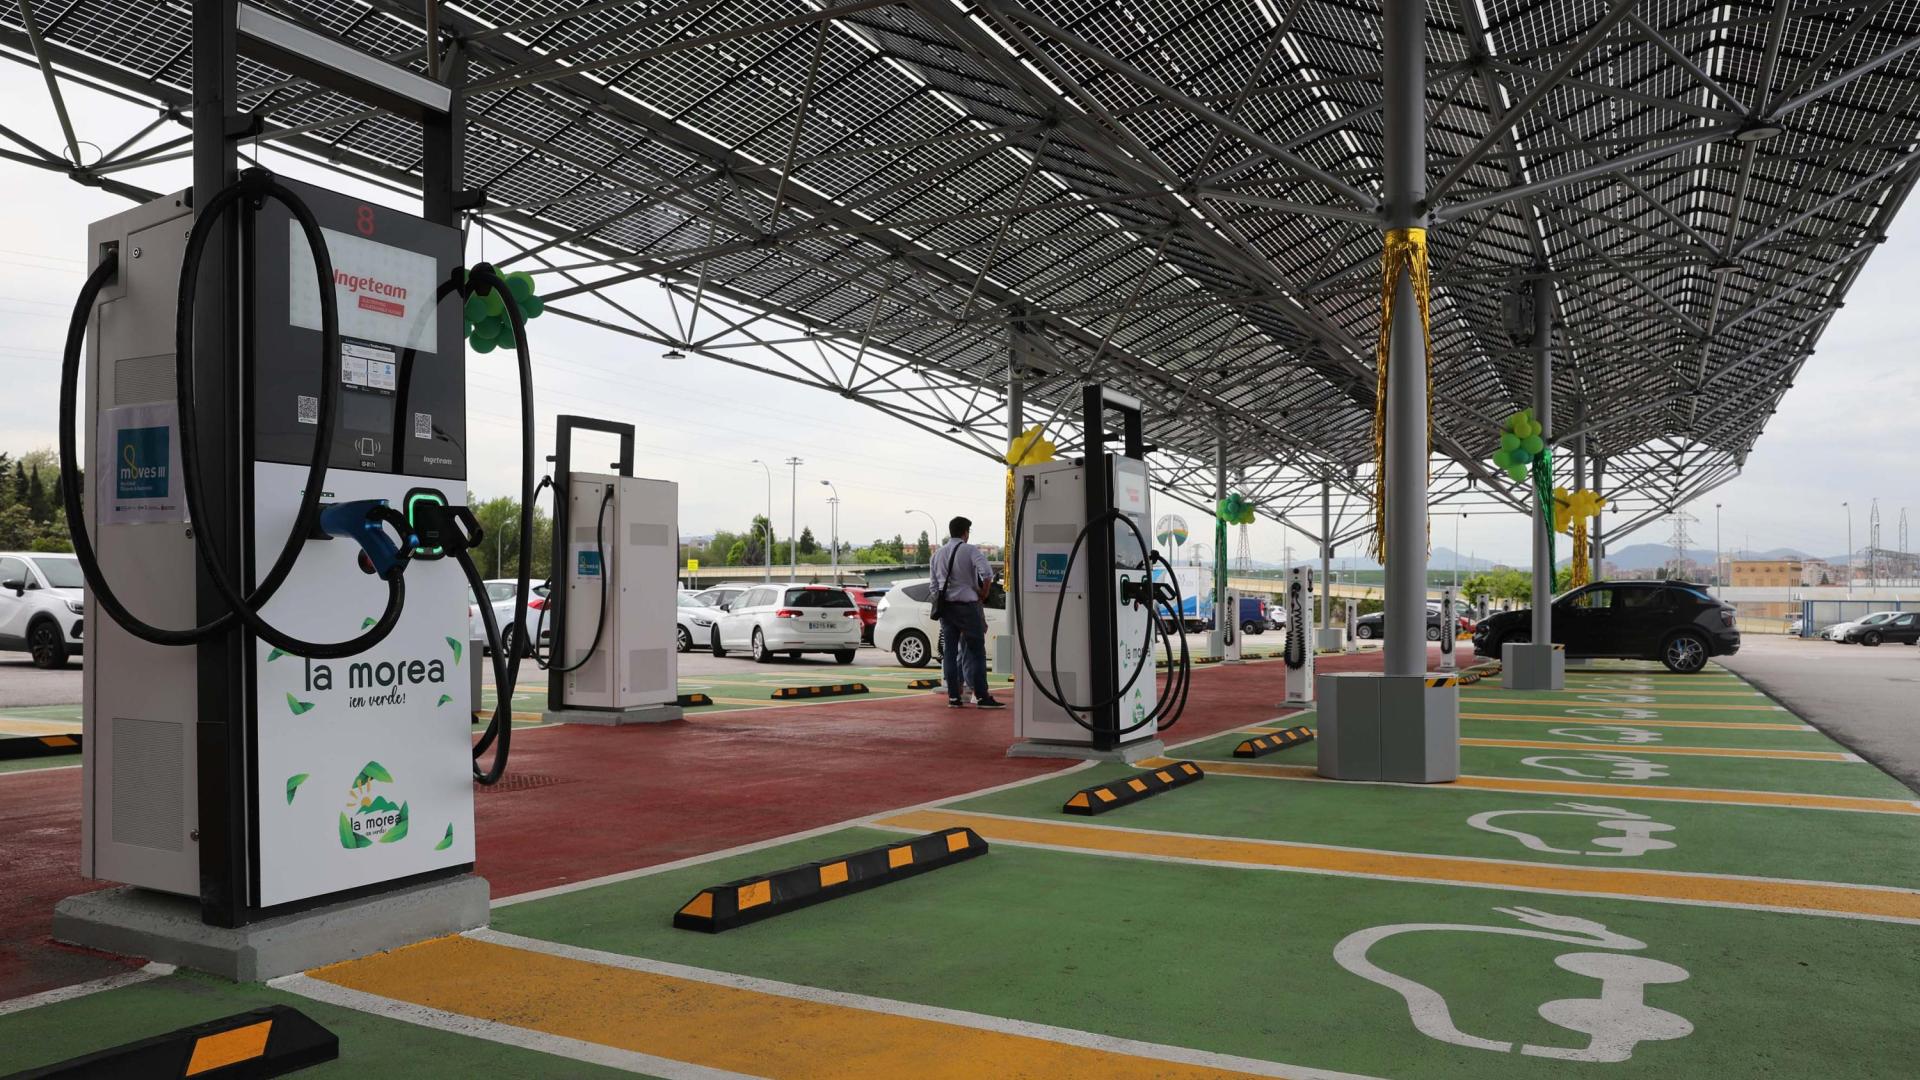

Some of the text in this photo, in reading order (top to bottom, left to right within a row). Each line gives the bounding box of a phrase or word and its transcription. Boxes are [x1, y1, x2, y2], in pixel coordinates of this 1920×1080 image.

[356, 204, 376, 236] 8
[334, 268, 407, 300] Ingeteam
[120, 466, 157, 480] moves
[305, 657, 445, 691] la morea
[368, 684, 406, 707] verde!
[350, 813, 402, 831] la morea
